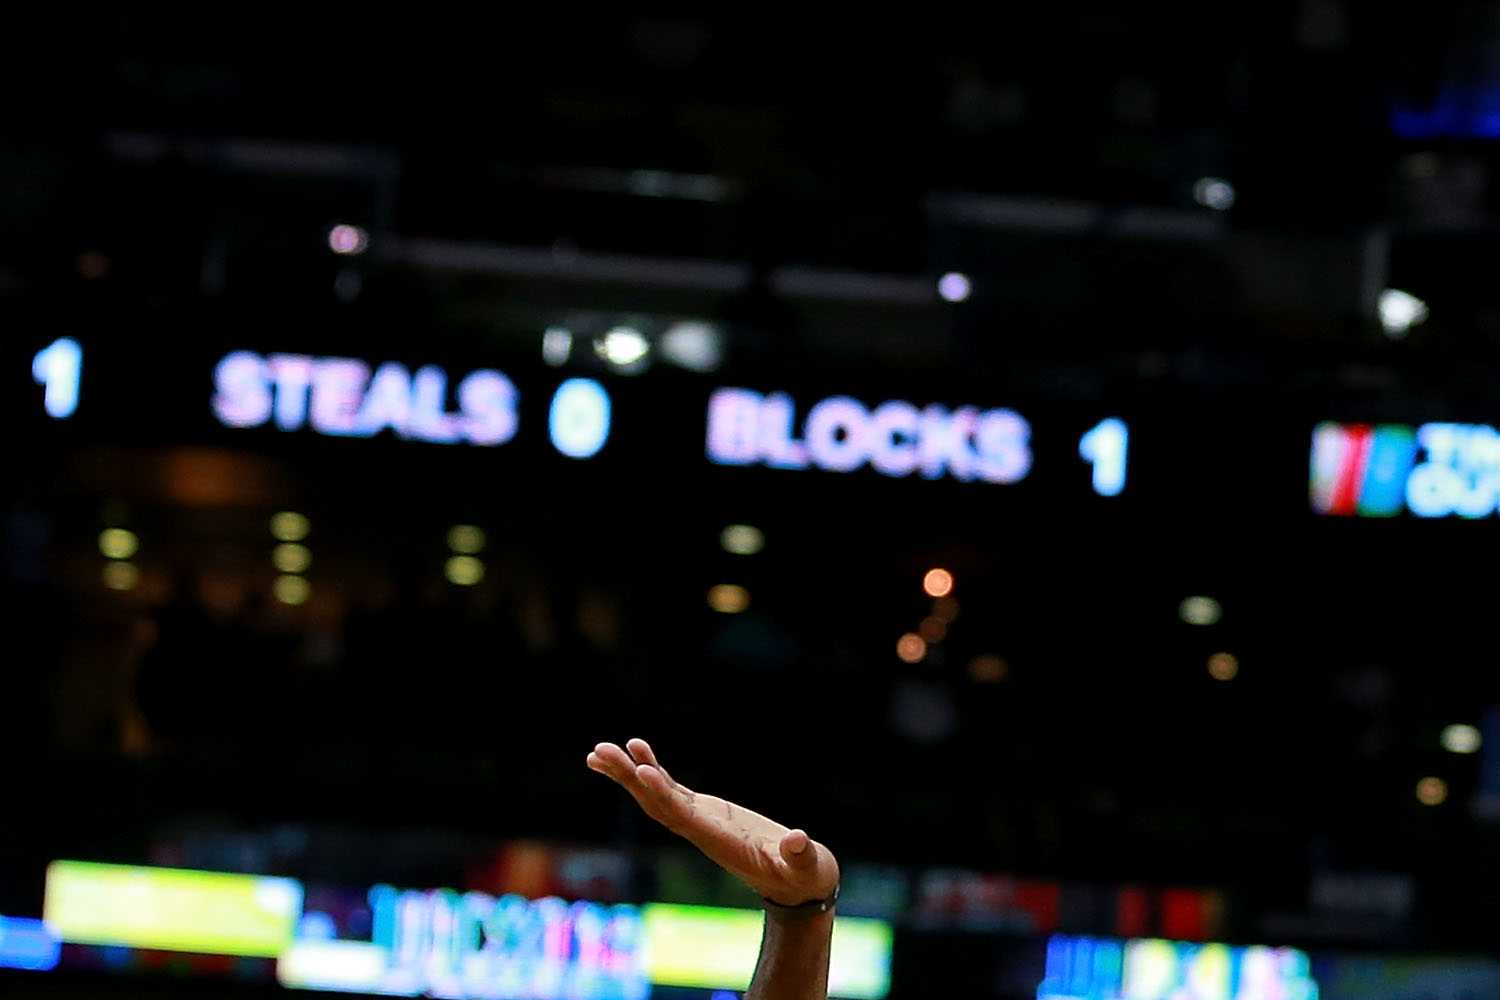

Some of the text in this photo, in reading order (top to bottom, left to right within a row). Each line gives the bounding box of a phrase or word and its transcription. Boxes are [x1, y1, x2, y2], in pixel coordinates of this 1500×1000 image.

[32, 337, 1129, 496] 1 STEALS 0 BLOCKS 1
